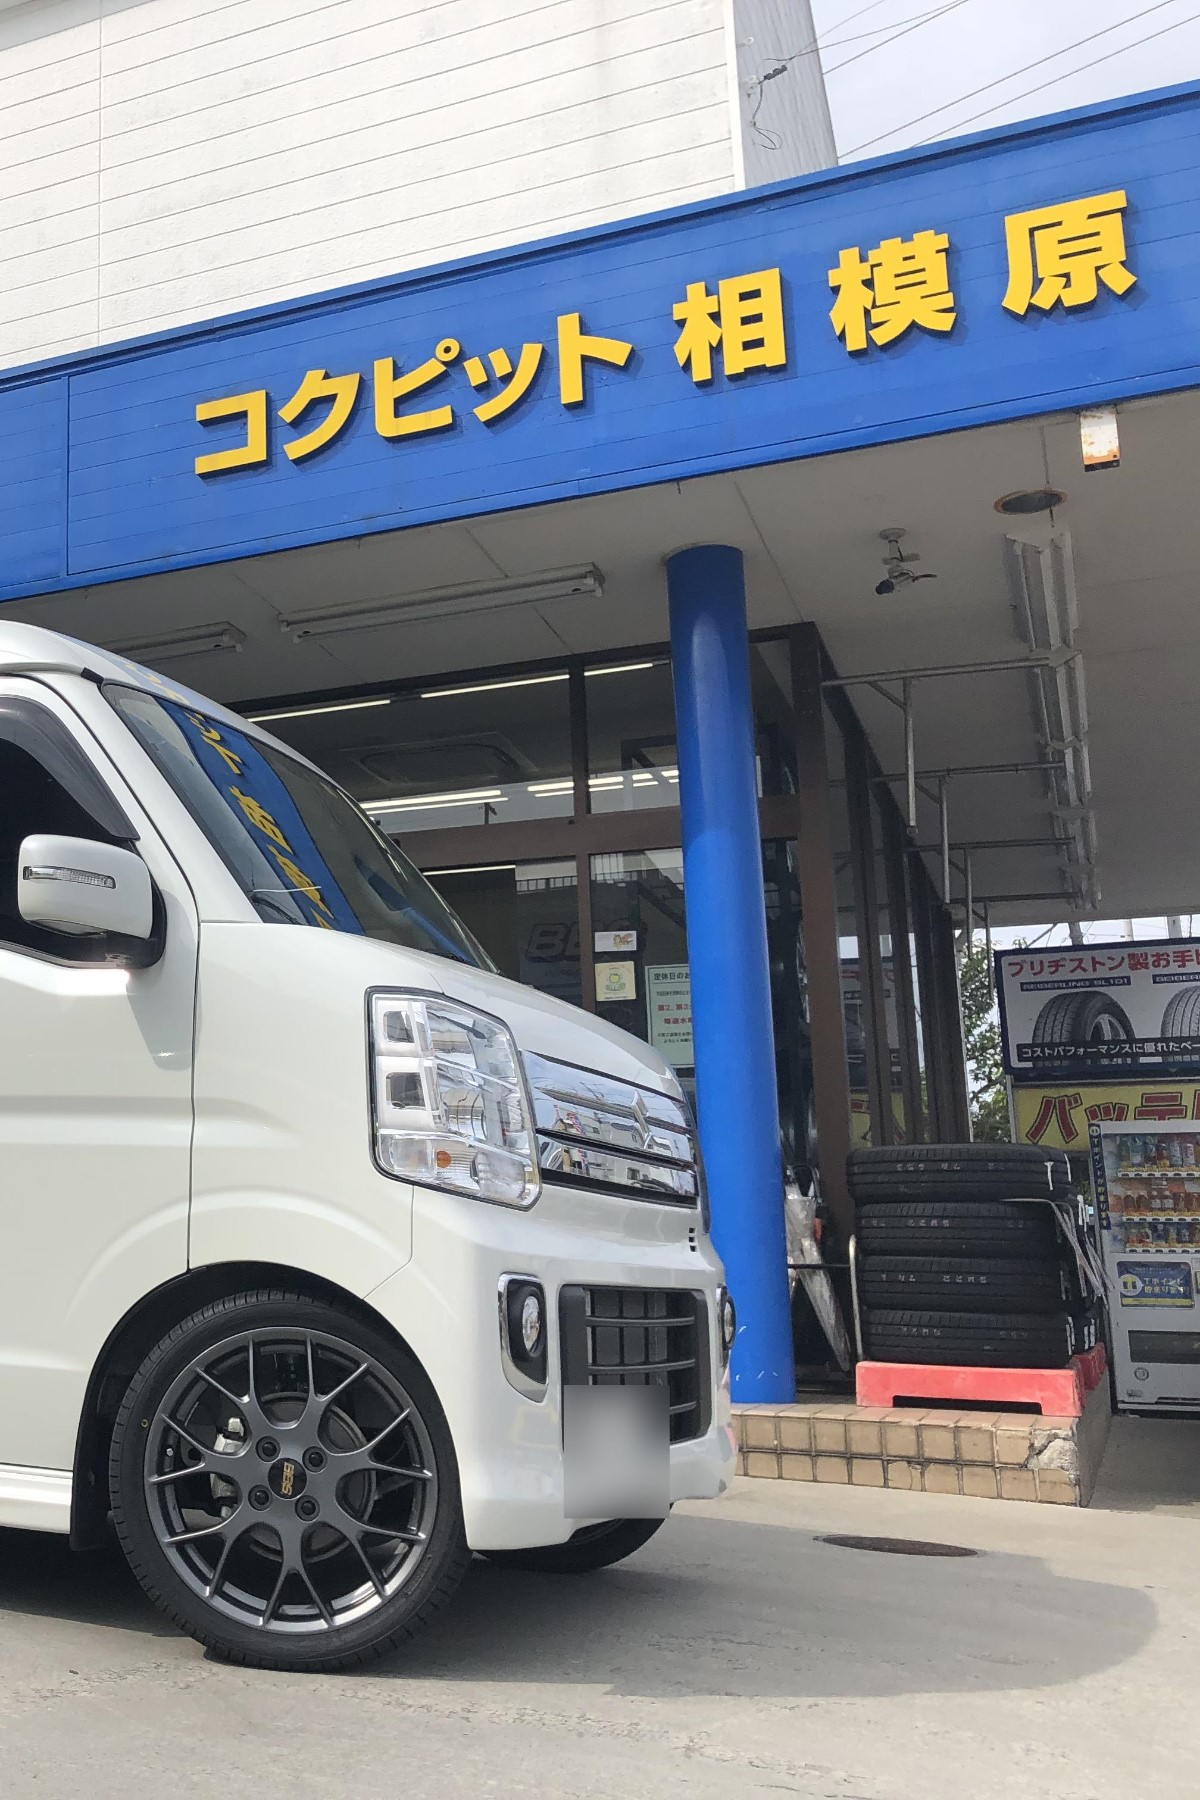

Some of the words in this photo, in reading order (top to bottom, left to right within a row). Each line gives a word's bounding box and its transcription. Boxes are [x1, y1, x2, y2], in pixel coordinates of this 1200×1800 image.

[194, 311, 633, 476] コクピット
[1007, 948, 1200, 977] ブリヂストン製お手
[281, 1461, 295, 1496] BBS
